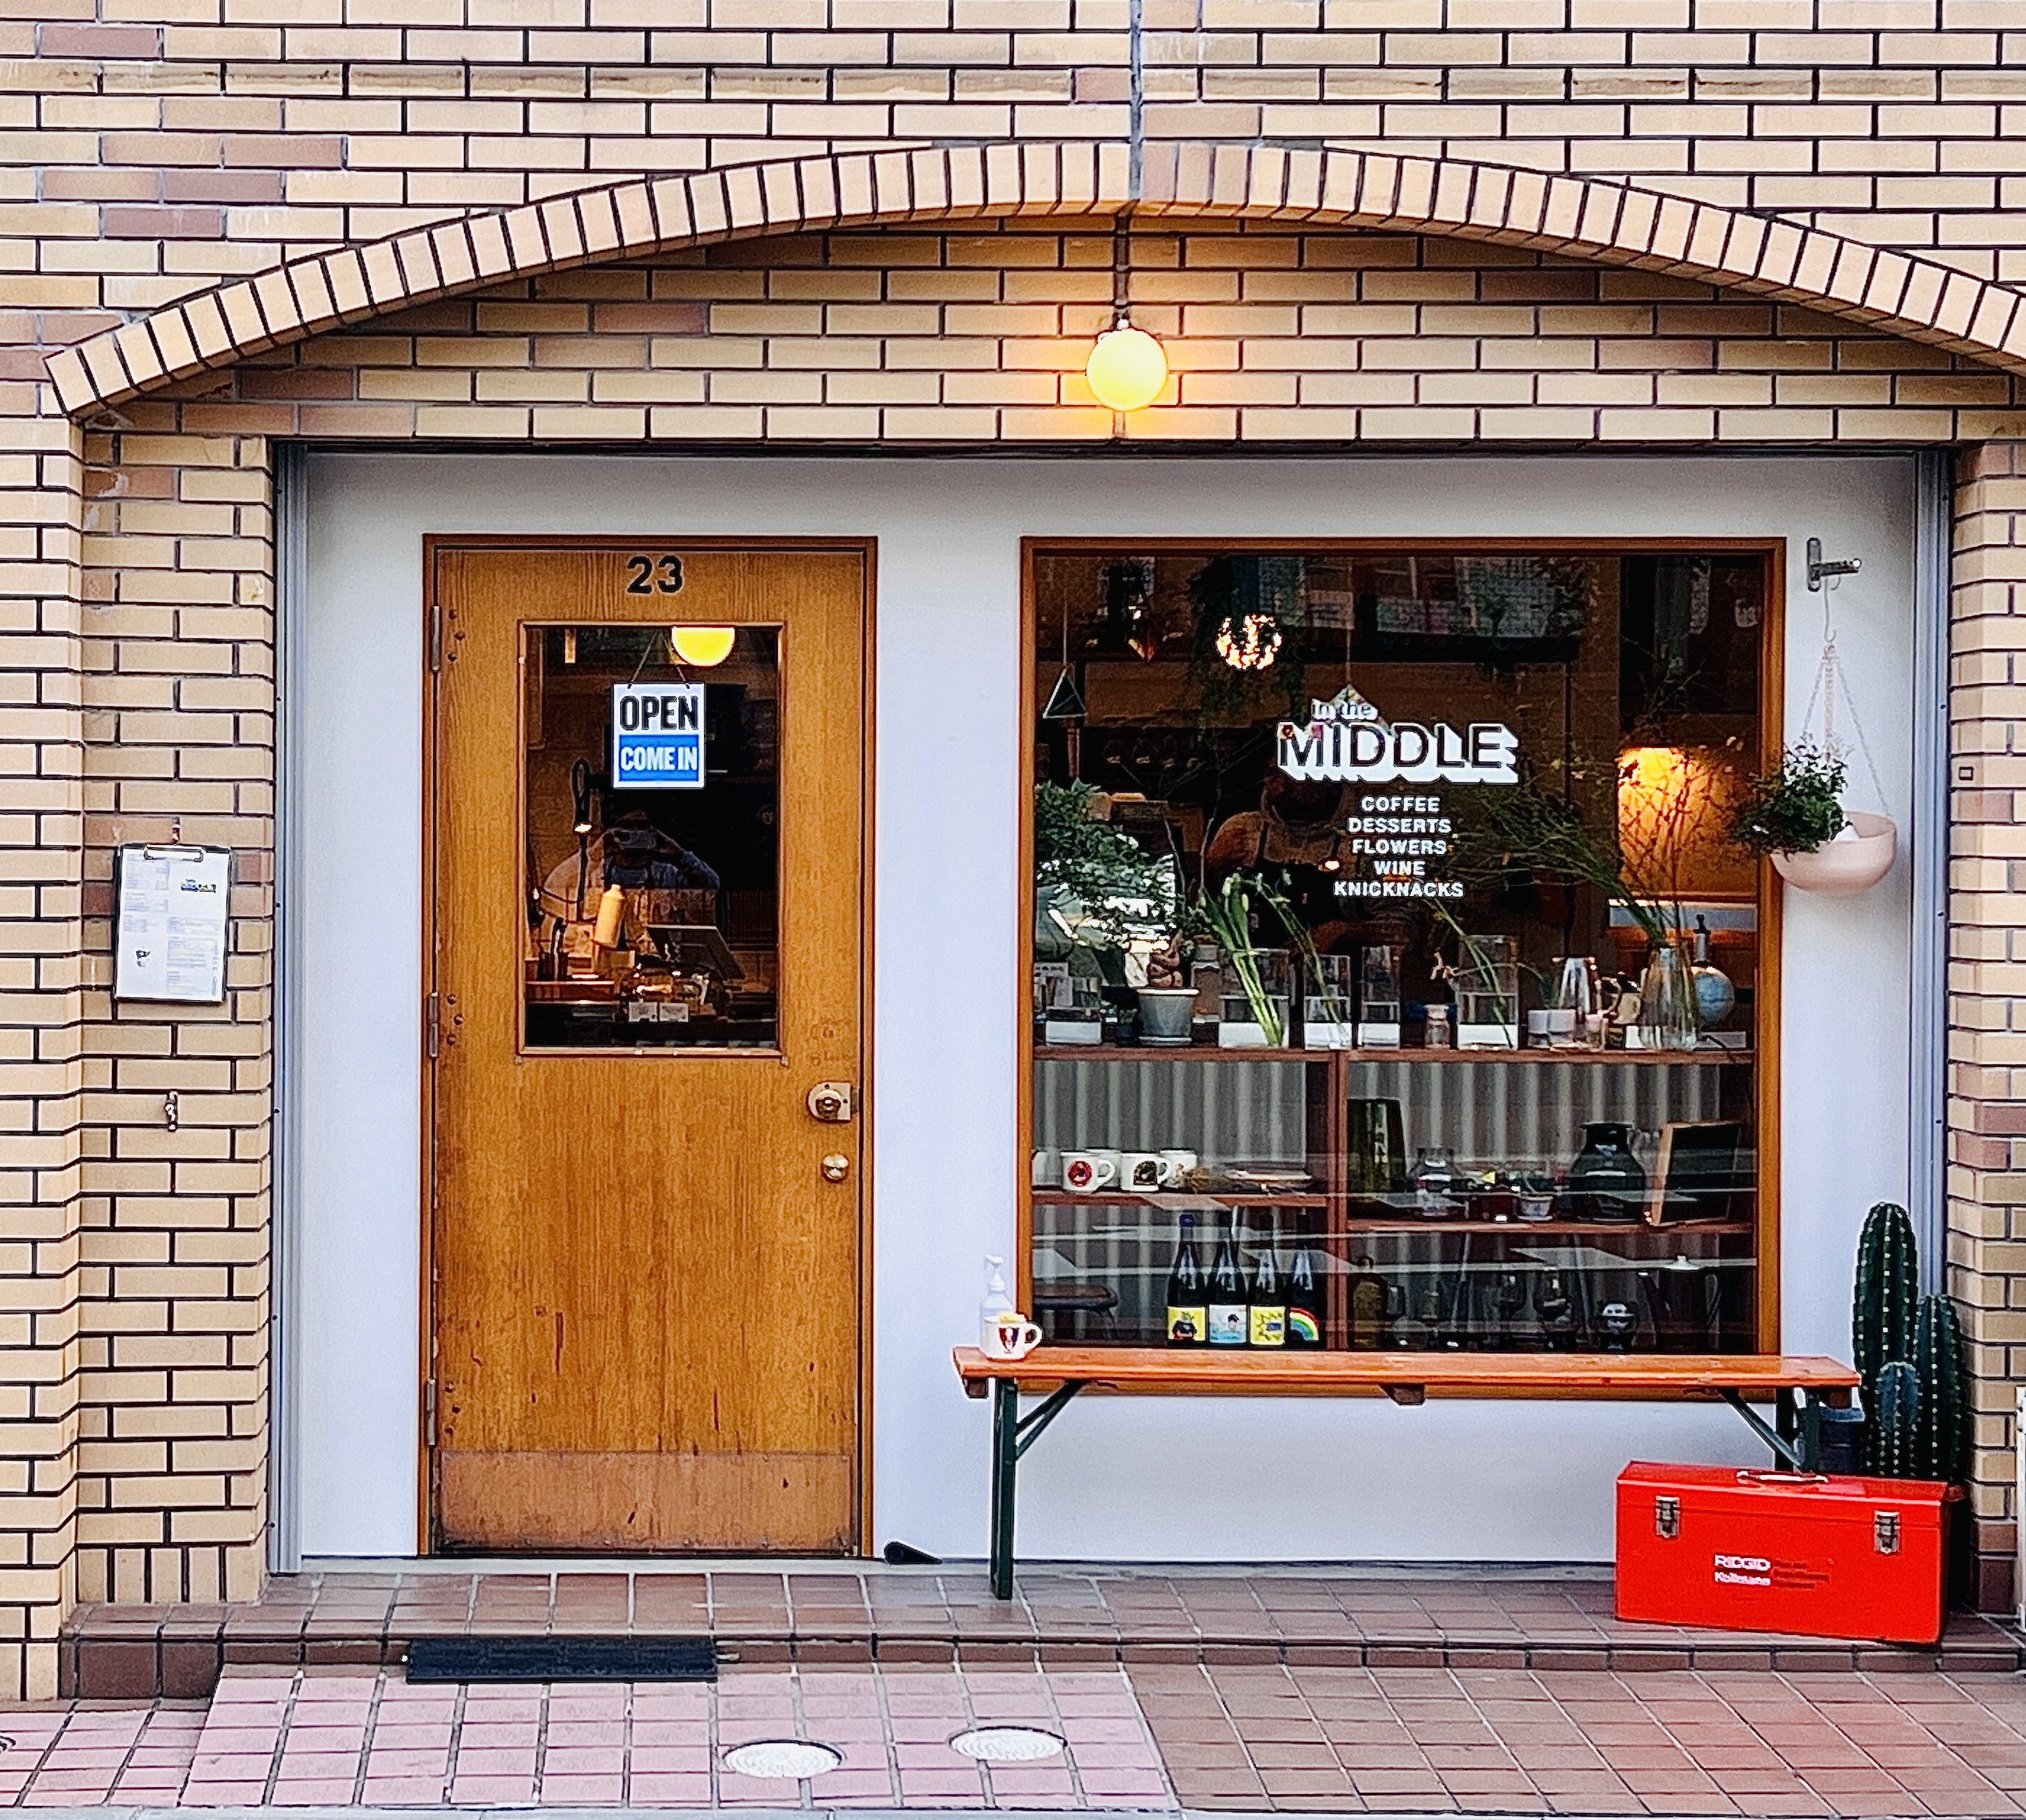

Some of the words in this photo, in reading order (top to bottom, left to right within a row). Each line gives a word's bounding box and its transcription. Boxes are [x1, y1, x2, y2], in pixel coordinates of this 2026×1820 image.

[627, 555, 682, 593] 23
[619, 696, 698, 731] OPEN
[1339, 699, 1378, 719] the
[620, 747, 675, 771] COME
[677, 747, 698, 770] IN
[1277, 722, 1518, 783] MIDDLE
[1361, 796, 1440, 812] COFFEE
[1348, 817, 1452, 833] DESSERTS
[1352, 839, 1447, 856] FLOWERS
[1374, 860, 1425, 876] WINE
[1334, 881, 1464, 897] KNICKNACKS
